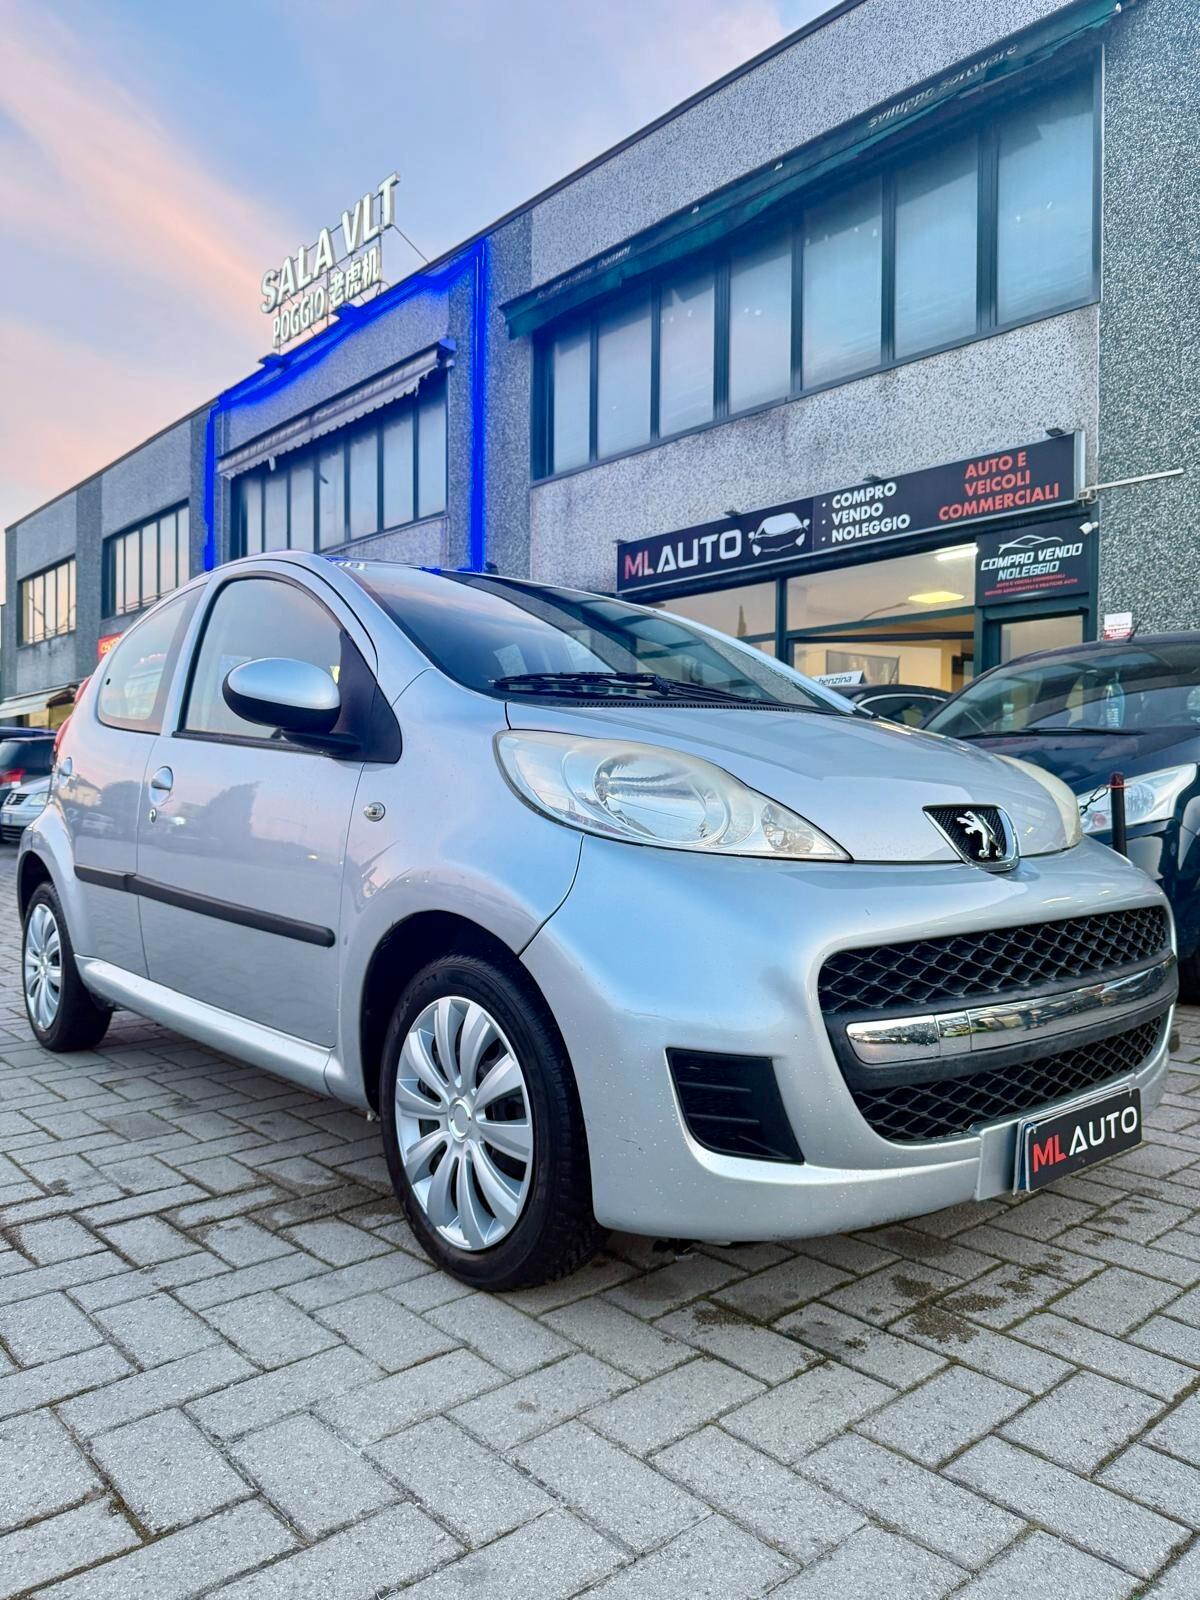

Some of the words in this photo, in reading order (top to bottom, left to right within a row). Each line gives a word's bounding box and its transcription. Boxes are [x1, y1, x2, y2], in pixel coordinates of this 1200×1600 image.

[261, 228, 336, 313] SALA
[341, 171, 400, 254] VLT
[272, 286, 326, 348] POGGIO
[329, 246, 381, 308] 老虎机
[965, 455, 1013, 479] AUTO
[1018, 451, 1027, 467] E
[831, 482, 897, 509] COMPRO
[964, 470, 1031, 497] VEICOLI
[832, 502, 883, 526] VENDO
[938, 483, 1059, 521] COMMERCIALI
[831, 513, 911, 543] NOLEGGIO
[980, 551, 1035, 571] COMPRO
[1037, 543, 1083, 562] VENDO
[997, 561, 1060, 581] NOLEGGIO
